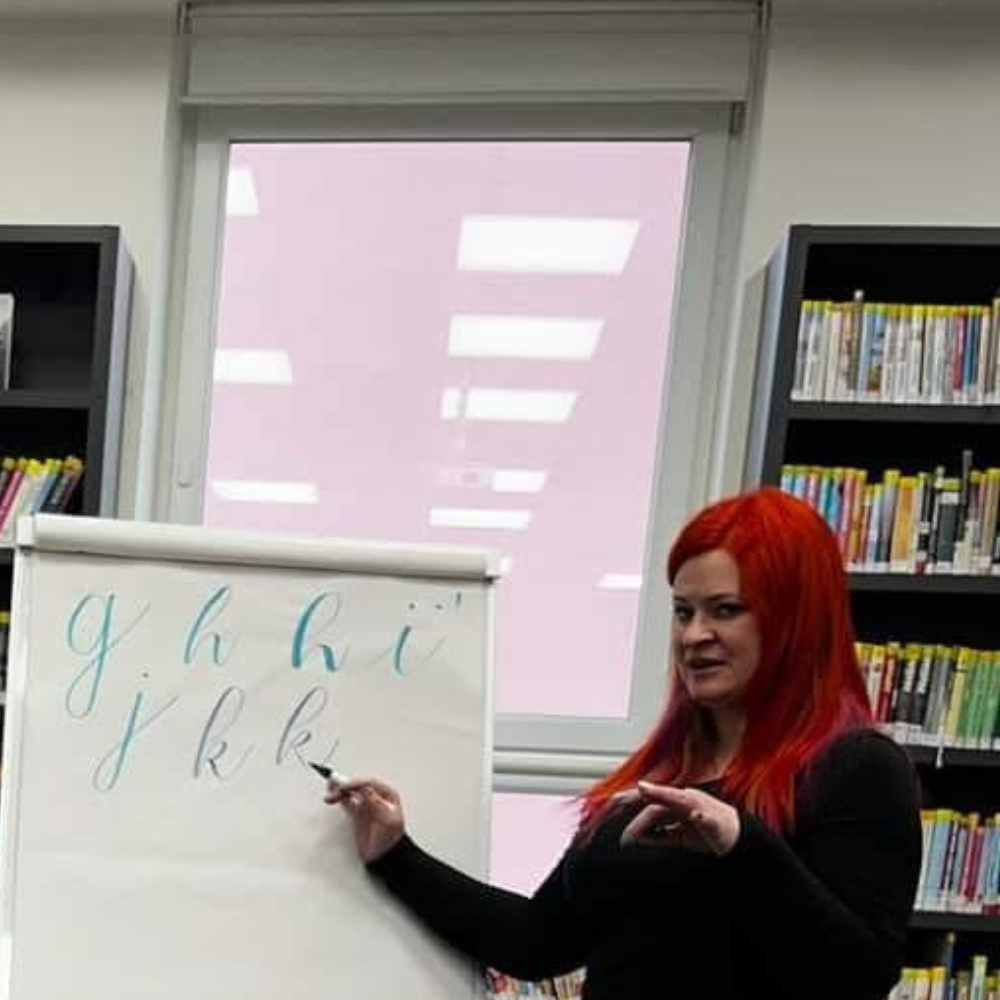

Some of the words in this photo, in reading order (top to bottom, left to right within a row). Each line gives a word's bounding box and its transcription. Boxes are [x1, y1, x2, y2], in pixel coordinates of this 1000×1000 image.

[183, 585, 238, 667] h
[290, 591, 350, 673] h
[193, 685, 255, 782] k
[275, 685, 340, 768] k
